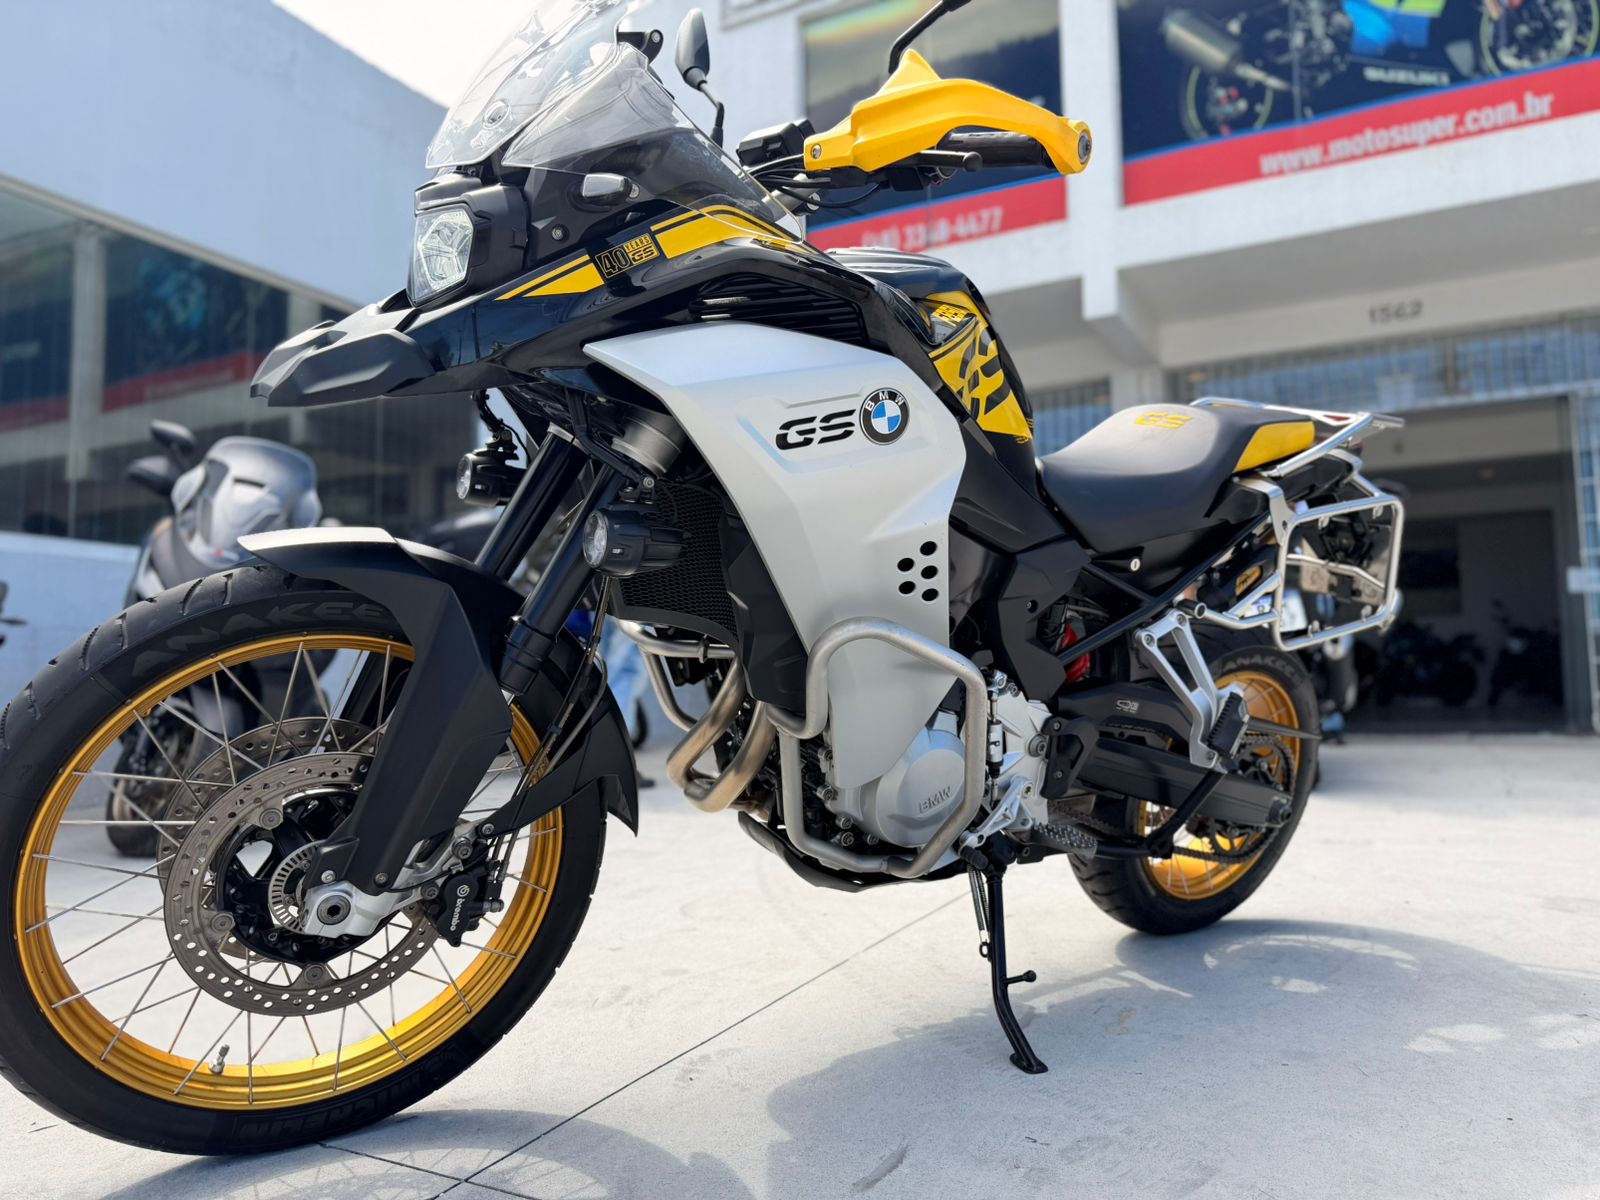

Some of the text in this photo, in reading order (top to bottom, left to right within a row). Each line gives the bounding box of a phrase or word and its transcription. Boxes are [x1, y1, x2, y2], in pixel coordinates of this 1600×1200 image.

[1258, 91, 1554, 175] www.motosuper.com.br
[624, 236, 650, 251] YEARS
[631, 245, 656, 262] GS
[602, 247, 631, 273] 40
[864, 390, 906, 412] BMW
[775, 408, 857, 451] GS
[1135, 410, 1193, 430] GS
[919, 785, 951, 814] BMW
[450, 897, 466, 931] brembo
